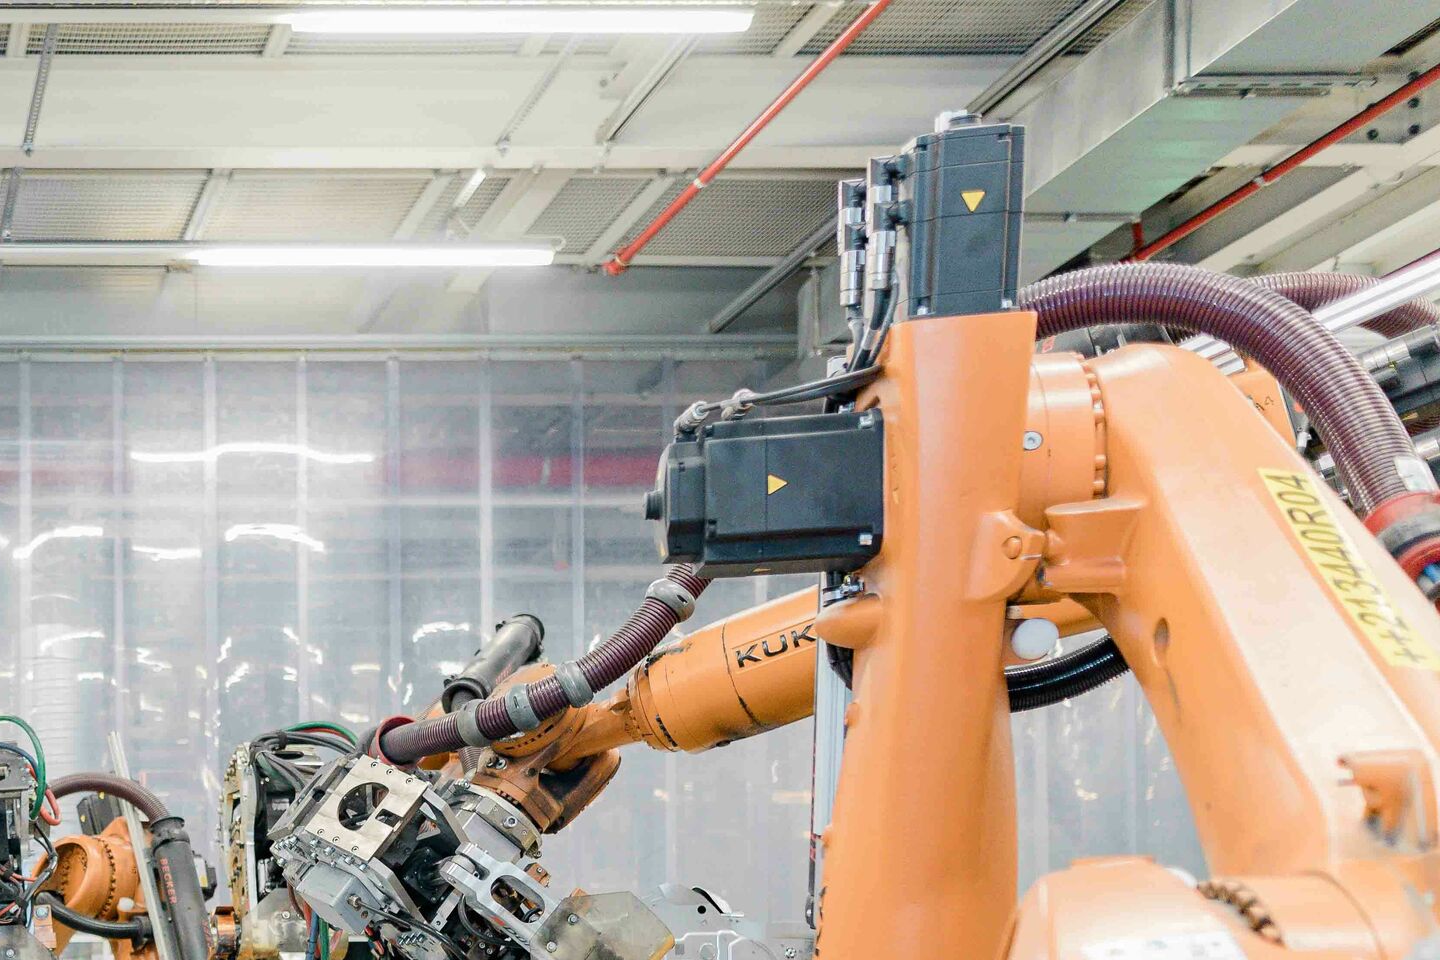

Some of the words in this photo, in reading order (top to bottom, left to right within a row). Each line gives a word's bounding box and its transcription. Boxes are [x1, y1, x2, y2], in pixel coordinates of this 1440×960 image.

[1264, 474, 1427, 662] ++213440R04
[735, 624, 817, 668] KUK
[160, 858, 177, 904] BECKER
